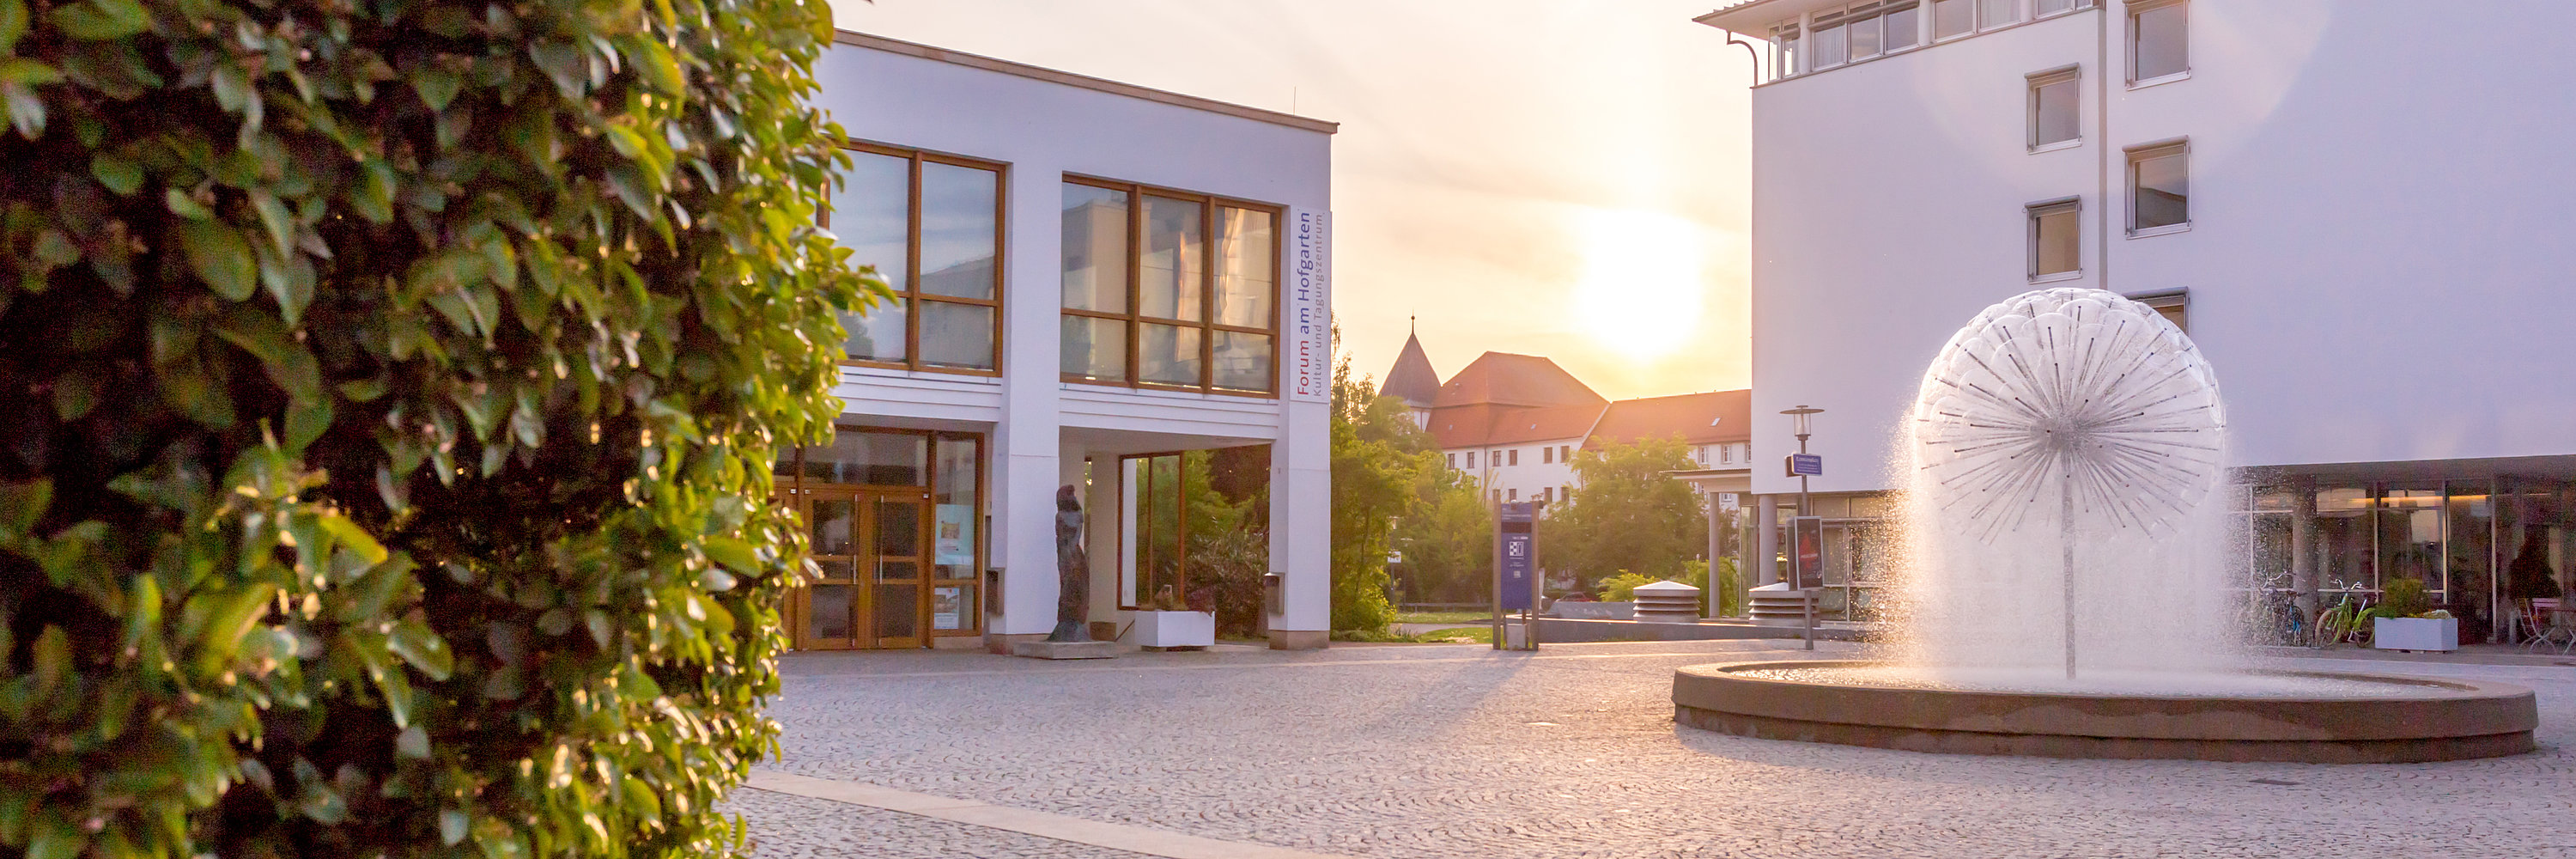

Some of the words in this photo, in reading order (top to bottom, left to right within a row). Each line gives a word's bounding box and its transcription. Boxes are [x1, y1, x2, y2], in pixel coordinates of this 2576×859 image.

[1297, 212, 1313, 301] Hofgarten
[1314, 215, 1324, 319] Tagungszentrum
[1299, 308, 1309, 334] am
[1297, 340, 1309, 395] Forum
[1313, 353, 1321, 396] Kultur-
